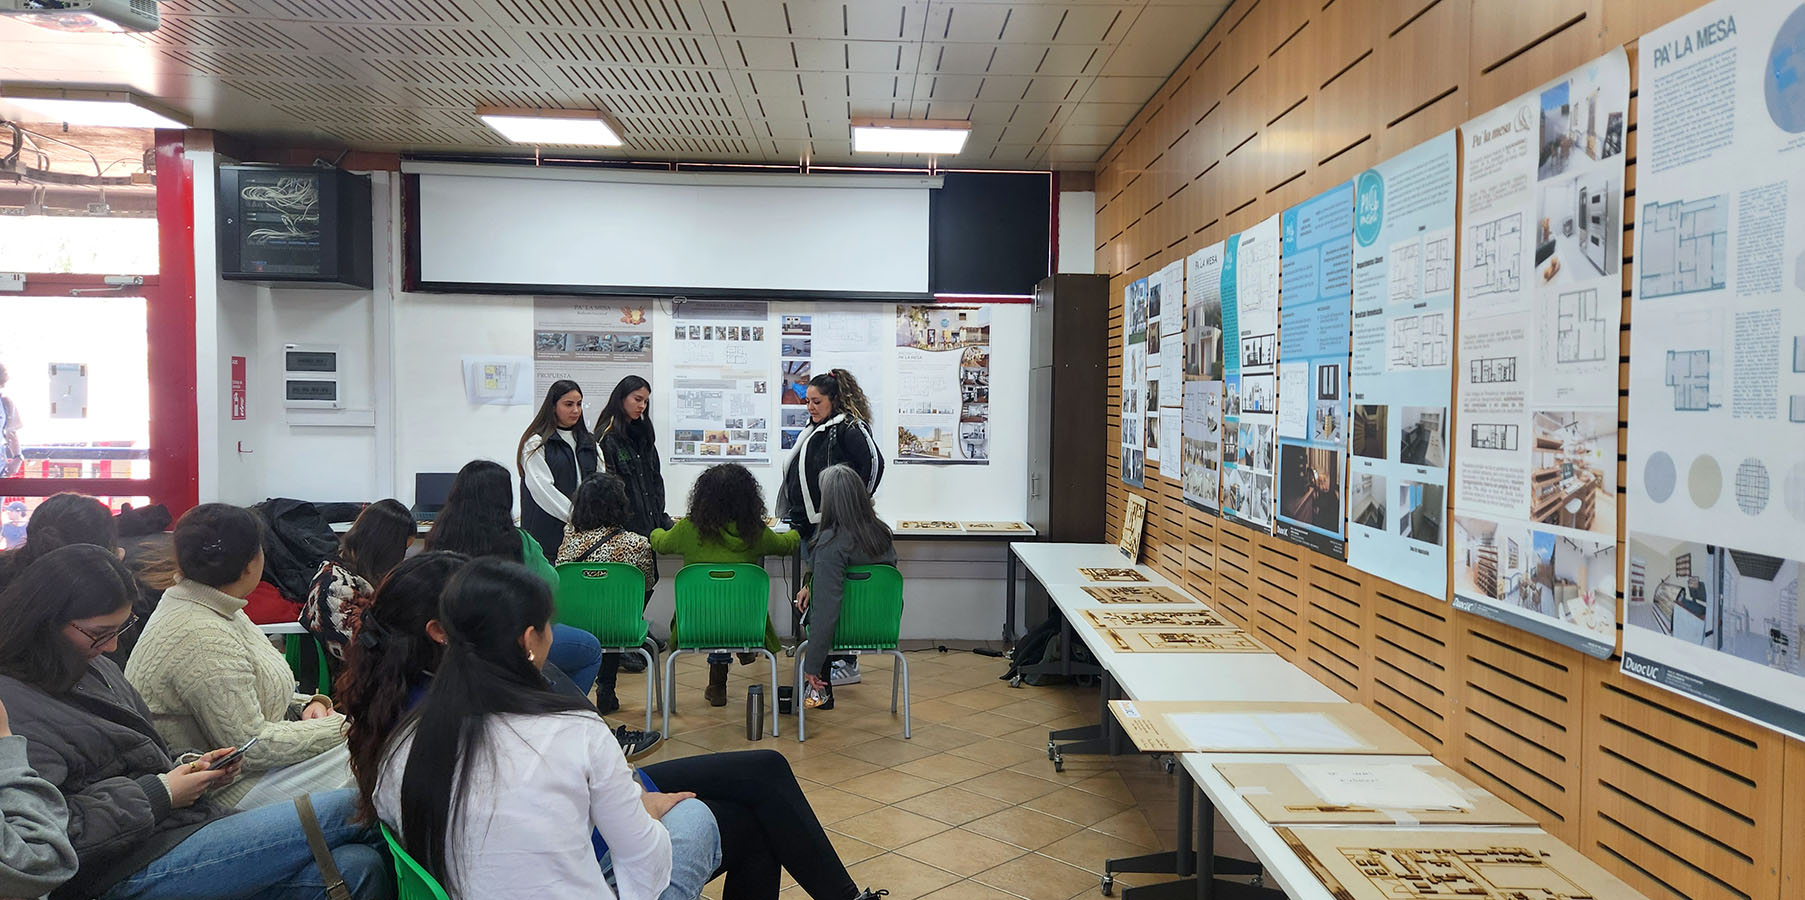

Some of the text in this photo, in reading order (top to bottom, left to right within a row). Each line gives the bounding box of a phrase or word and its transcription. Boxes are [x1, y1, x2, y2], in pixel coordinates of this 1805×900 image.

[1654, 15, 1737, 68] PA' LA MESA
